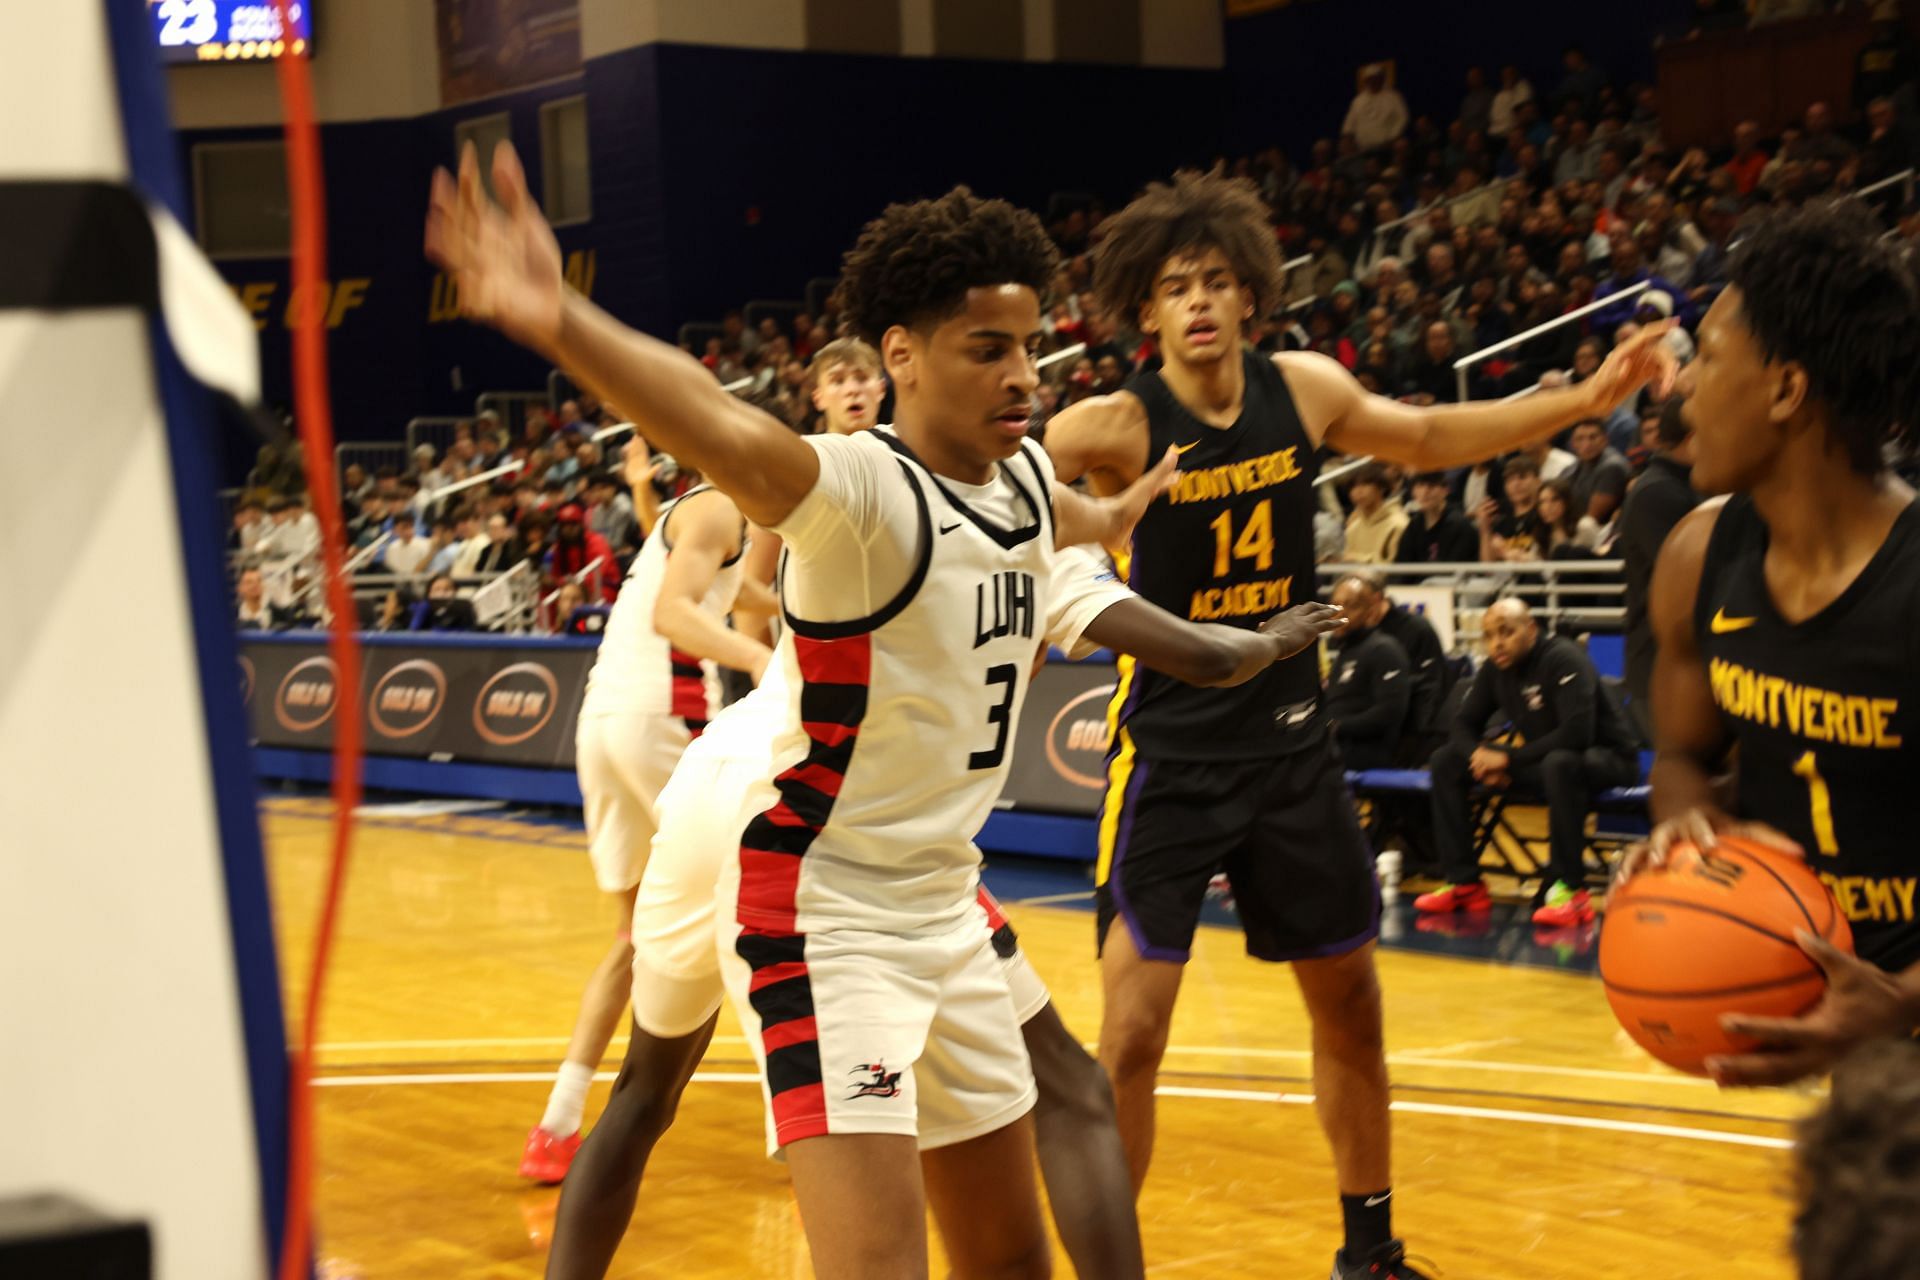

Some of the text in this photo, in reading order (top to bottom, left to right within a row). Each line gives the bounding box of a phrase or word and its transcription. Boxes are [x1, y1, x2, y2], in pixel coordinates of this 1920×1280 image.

[158, 0, 218, 46] 23
[1169, 445, 1302, 505] MONTVERDE
[1209, 498, 1276, 578] 14
[1188, 575, 1294, 622] ACADEMY
[968, 662, 1018, 770] 3
[1709, 656, 1902, 749] MONTVERDE
[1792, 750, 1839, 857] 1
